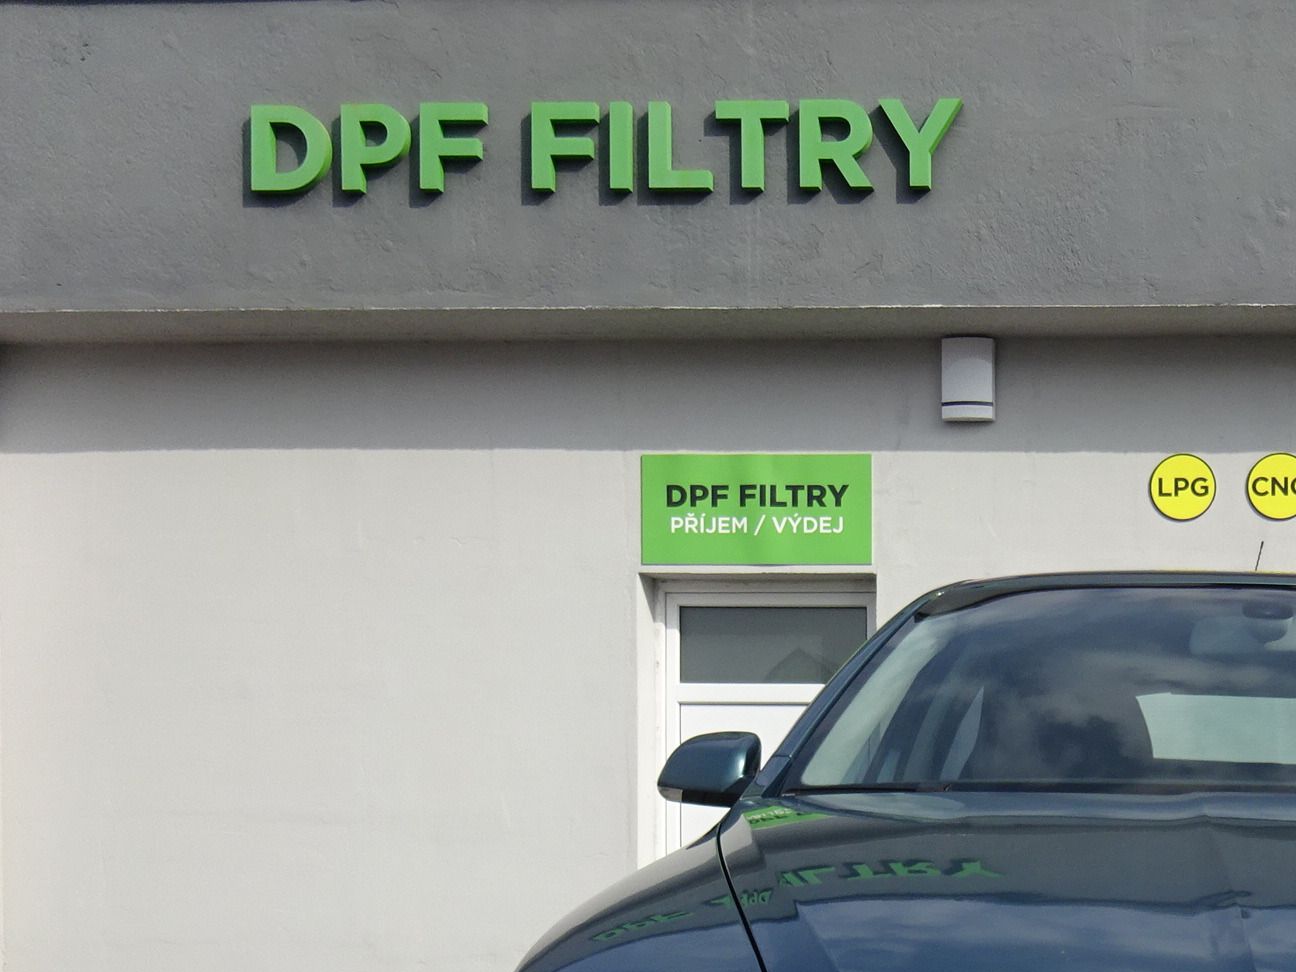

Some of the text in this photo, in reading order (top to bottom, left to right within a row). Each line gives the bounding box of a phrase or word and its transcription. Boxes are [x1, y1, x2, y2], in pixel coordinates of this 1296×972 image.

[249, 98, 964, 195] DPF FILTRY
[666, 484, 849, 507] DPF FILTRY
[1158, 476, 1210, 497] LPG
[670, 513, 844, 535] PŘÍJEM / VÝDEJ
